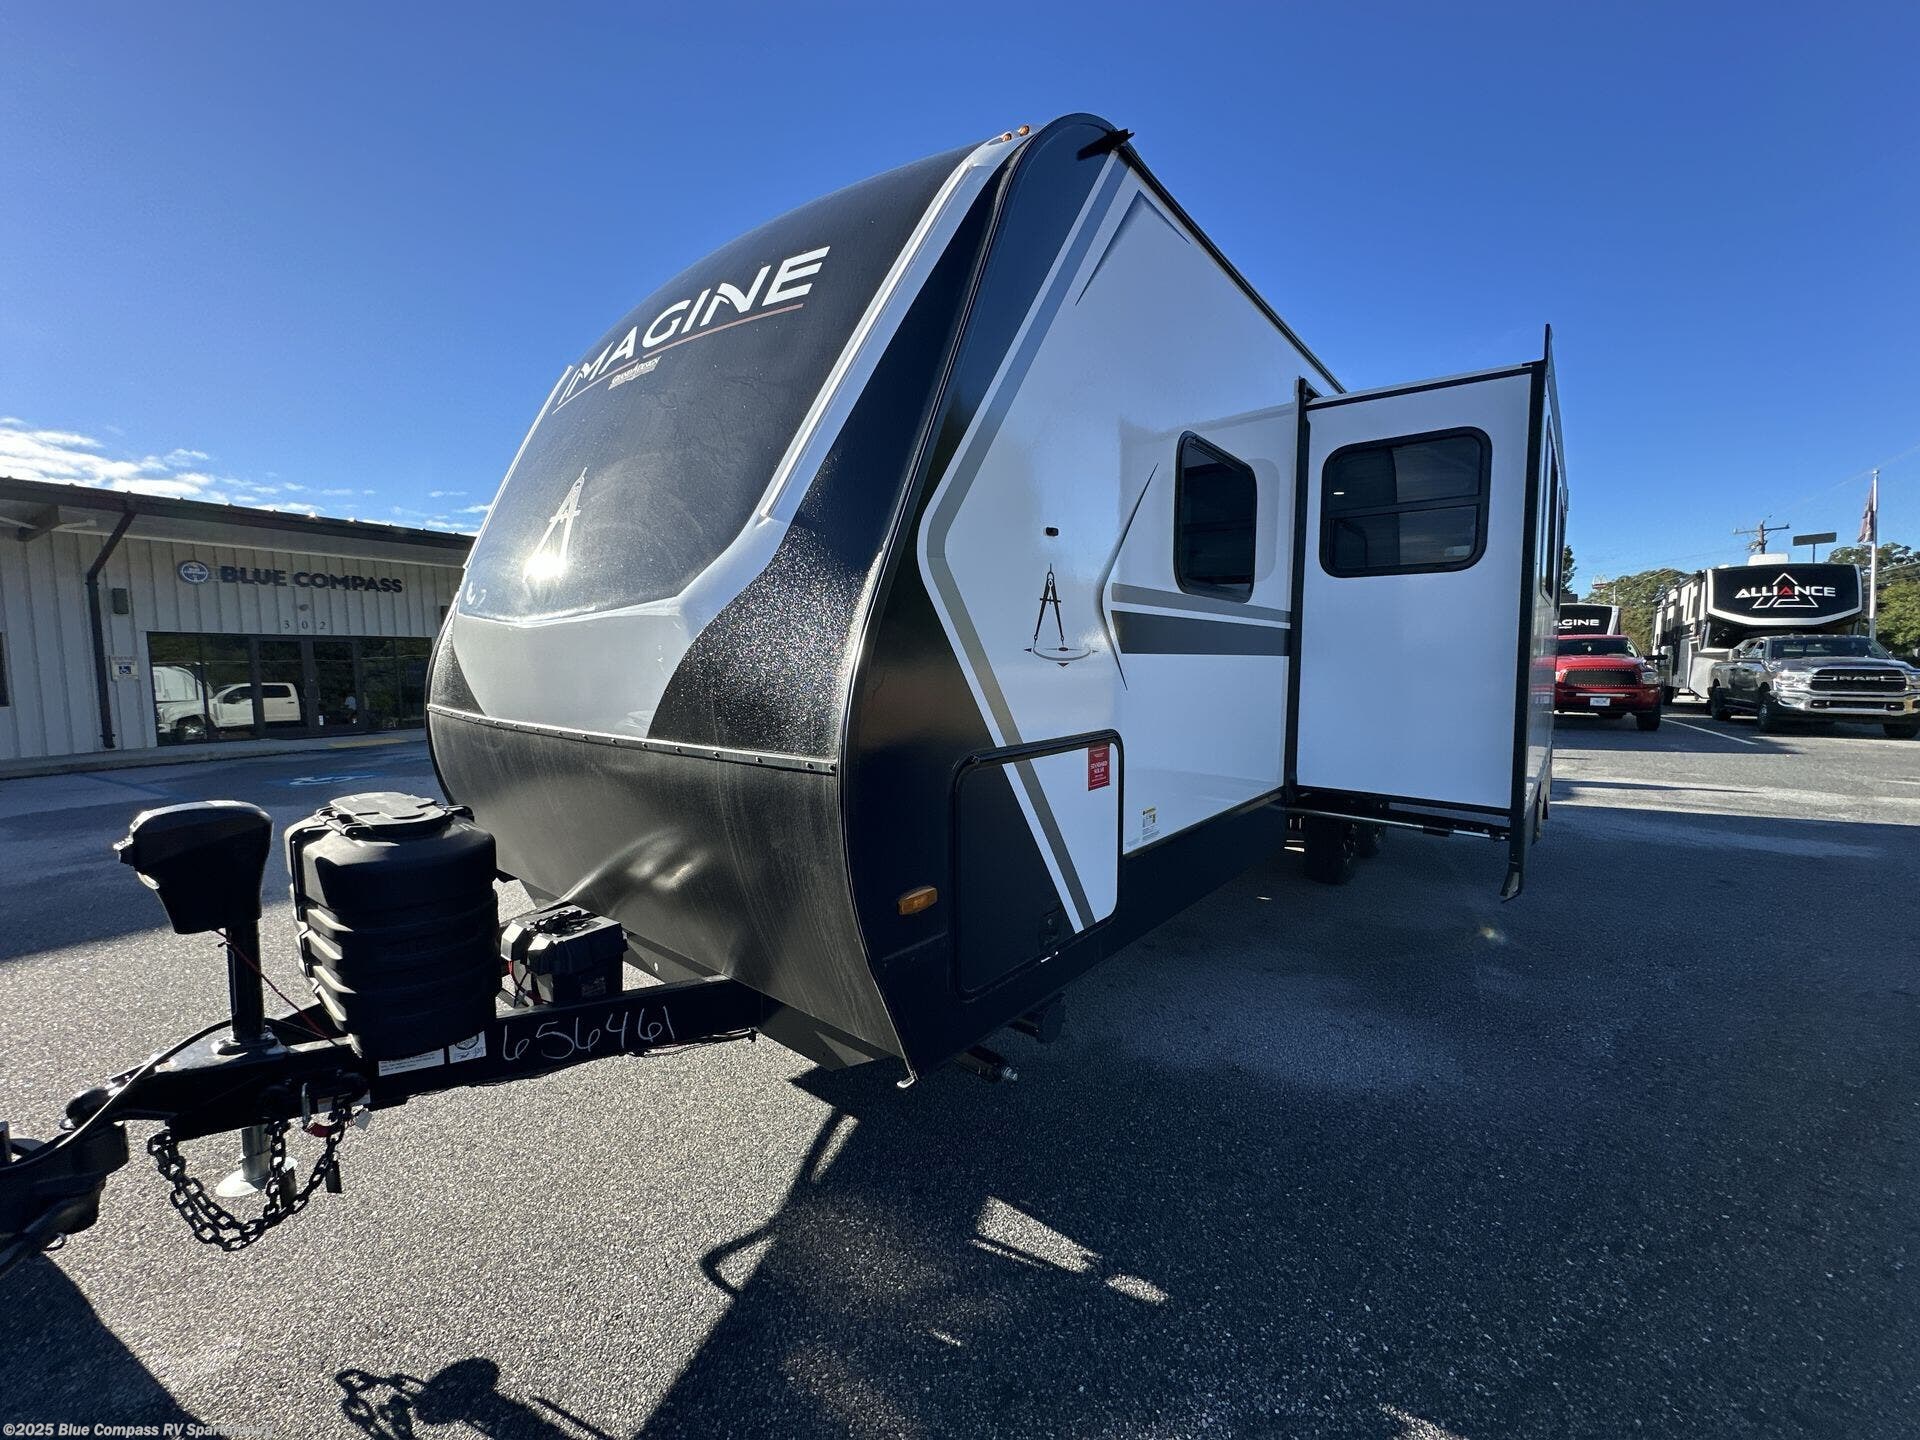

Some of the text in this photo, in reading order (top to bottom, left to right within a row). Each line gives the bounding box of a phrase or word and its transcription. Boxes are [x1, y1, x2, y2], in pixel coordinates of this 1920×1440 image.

[557, 245, 831, 406] IMAGINE
[220, 566, 287, 586] BLUE
[294, 572, 402, 592] COMPASS
[1735, 586, 1836, 598] ALLIANCE
[502, 1006, 676, 1061] 656461
